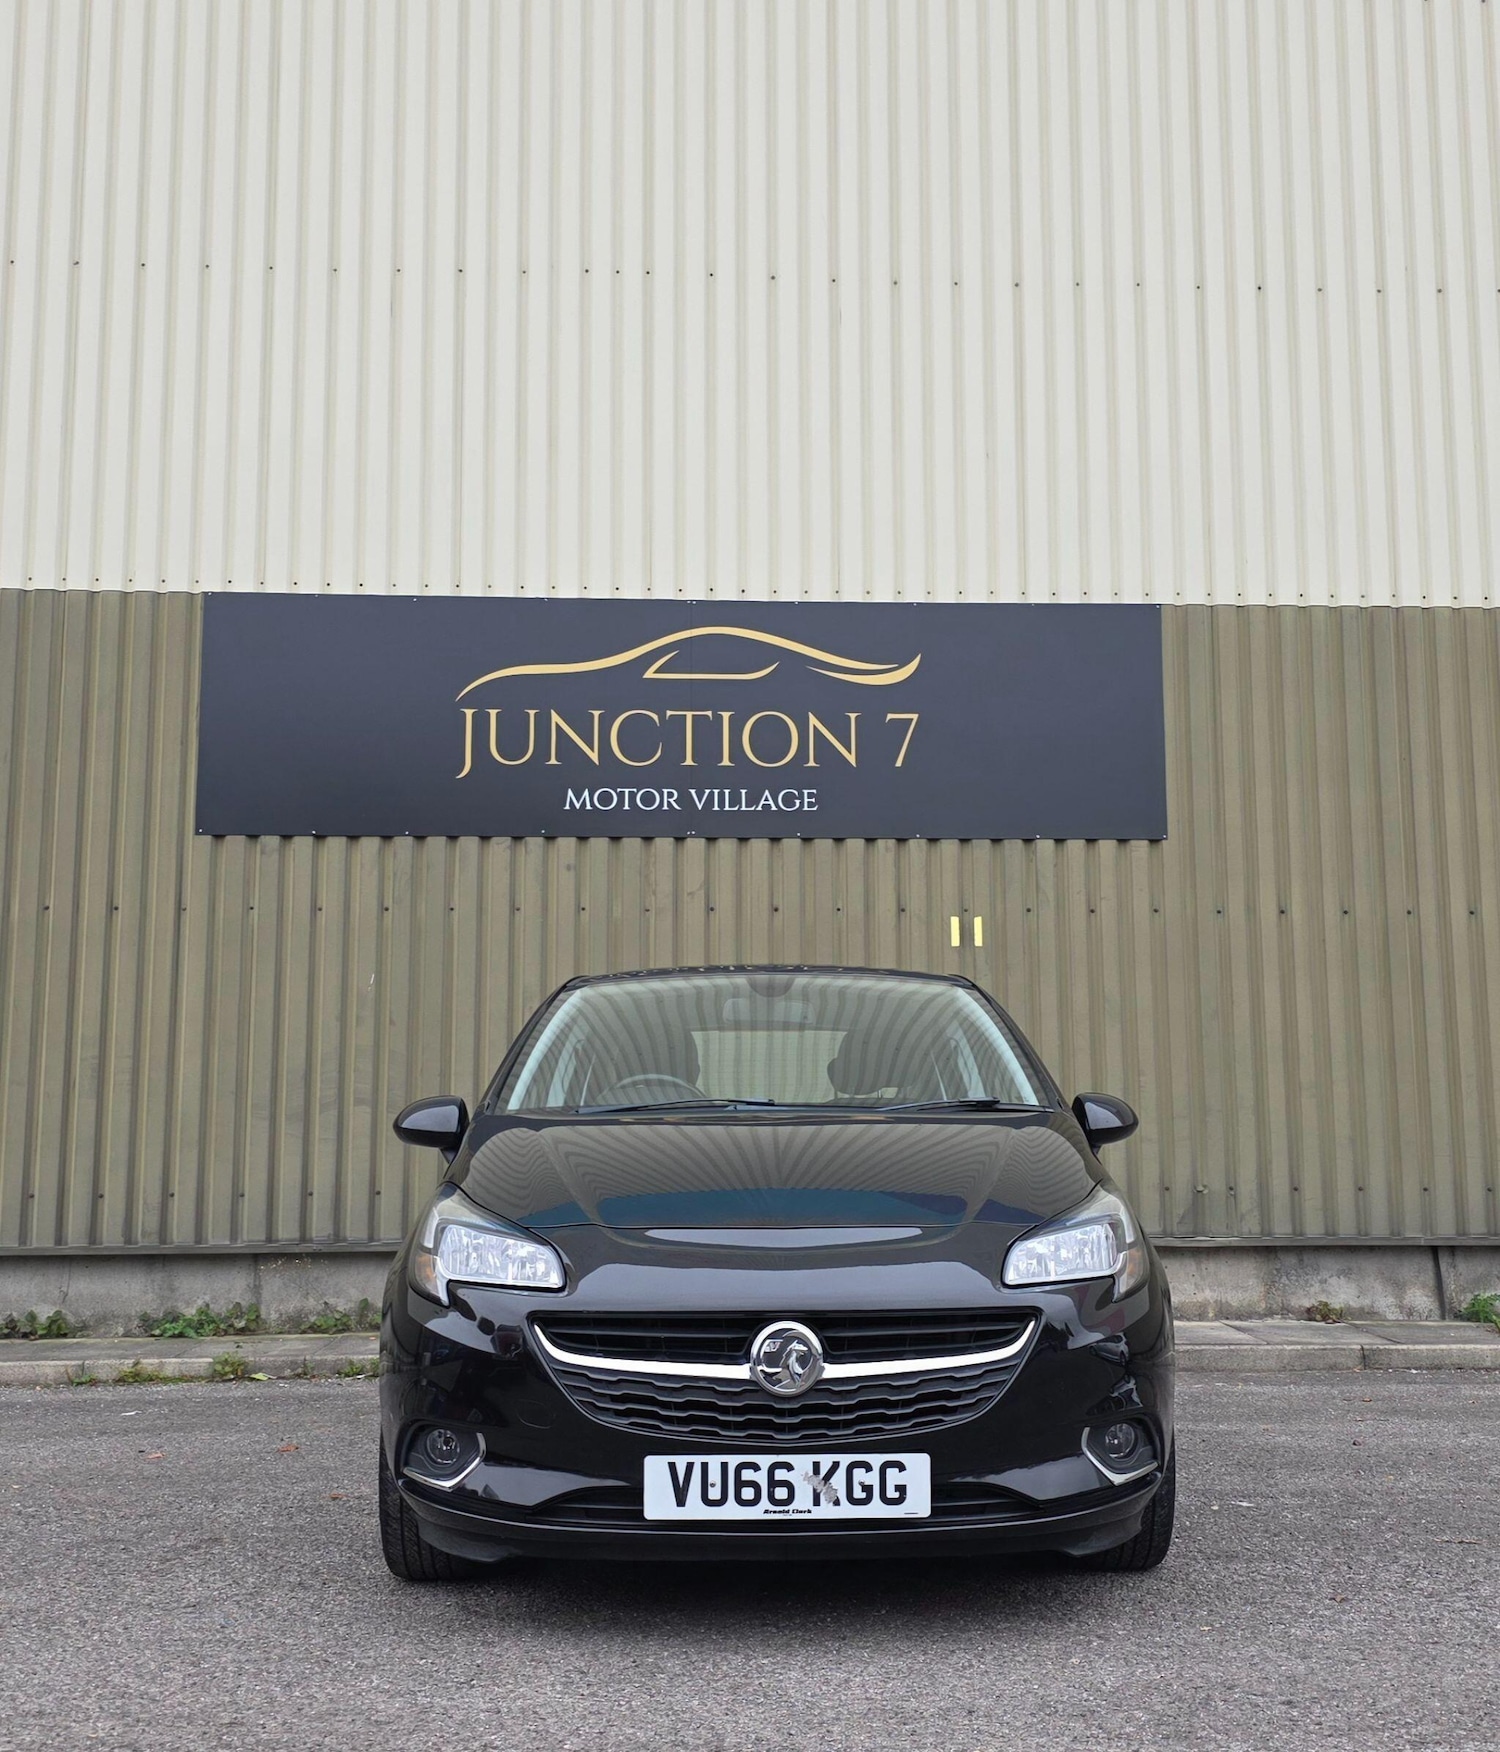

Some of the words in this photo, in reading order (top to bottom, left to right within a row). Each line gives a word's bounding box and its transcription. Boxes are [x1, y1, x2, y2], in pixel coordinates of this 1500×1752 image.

[455, 708, 862, 779] JUNCTION
[885, 712, 920, 768] 7
[563, 787, 682, 811] MOTOR
[688, 788, 819, 812] VILLAGE
[667, 1461, 796, 1508] VU66
[812, 1460, 908, 1507] KGG
